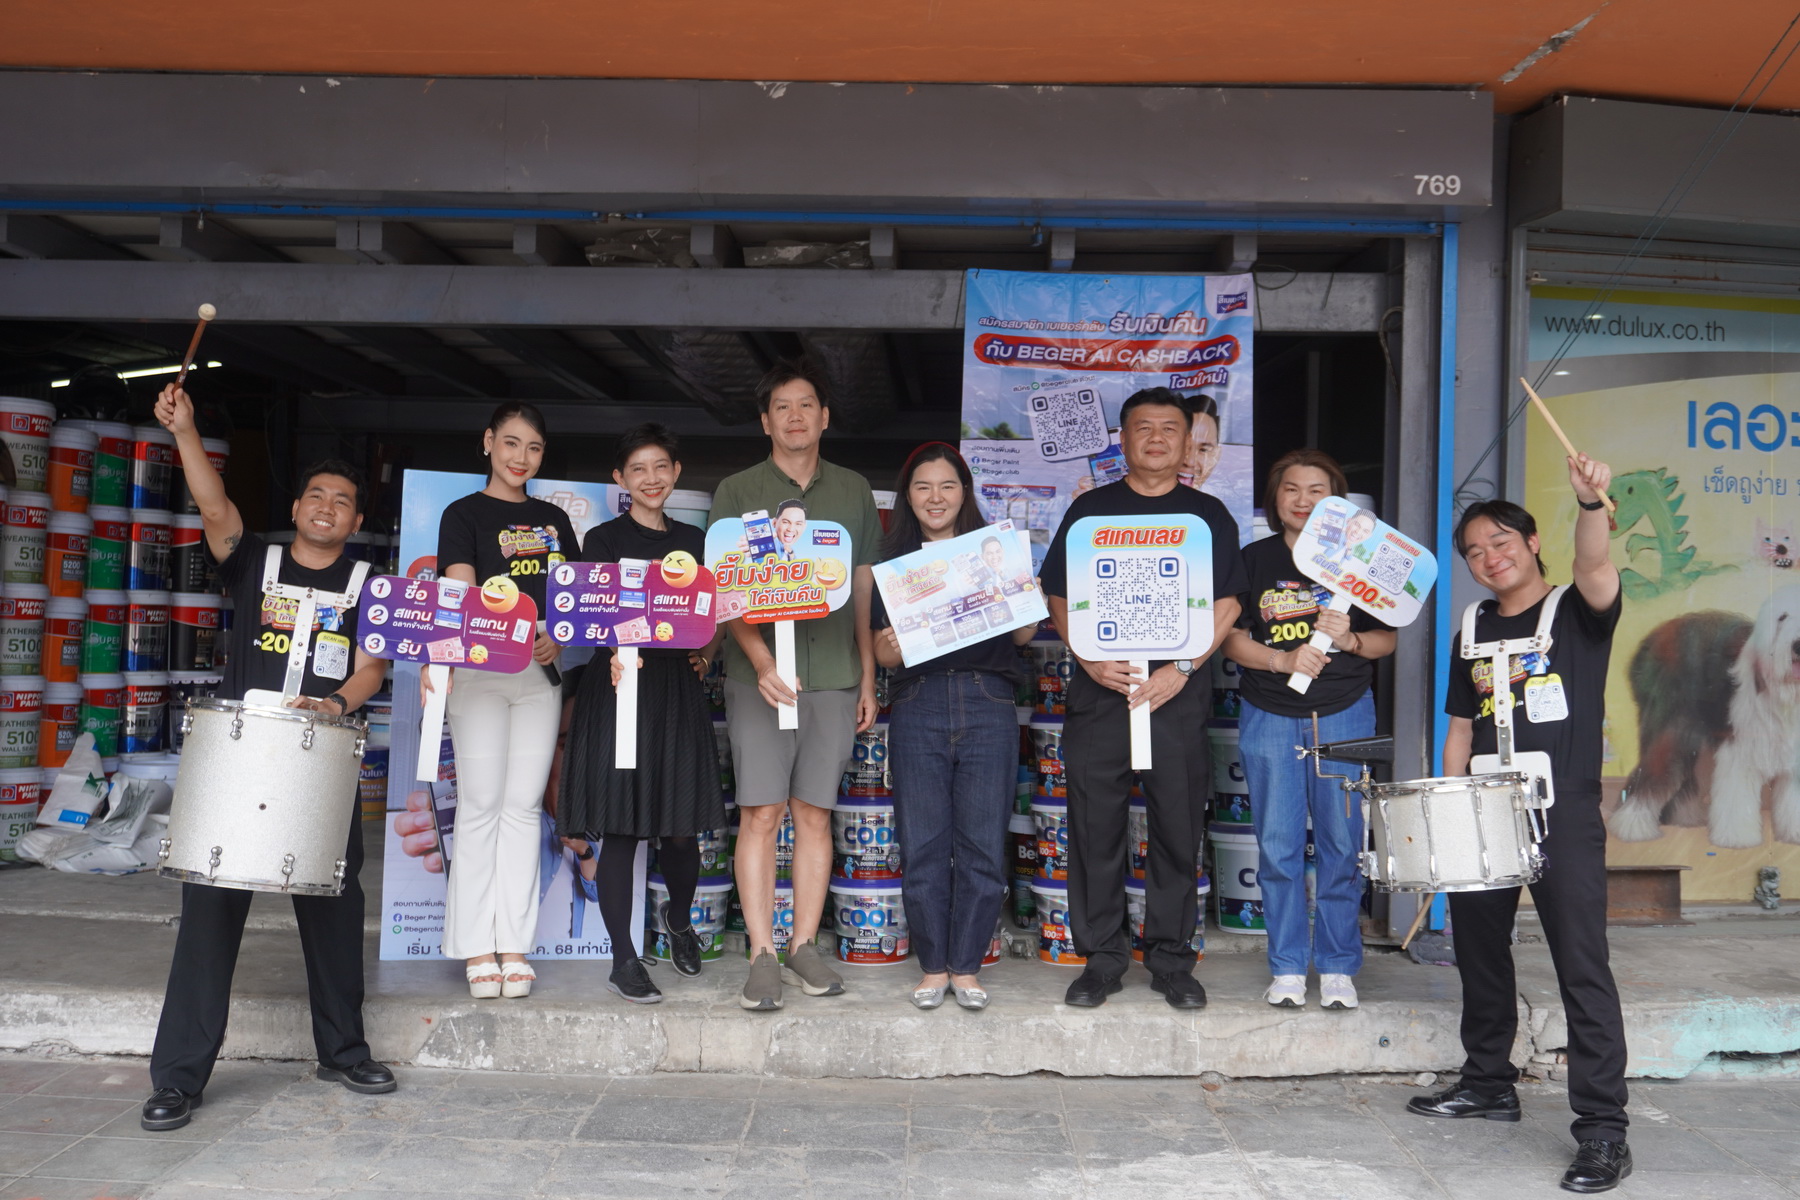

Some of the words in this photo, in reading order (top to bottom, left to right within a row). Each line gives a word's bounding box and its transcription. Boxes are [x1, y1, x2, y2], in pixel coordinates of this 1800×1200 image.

[1414, 174, 1461, 195] 769
[978, 316, 1044, 331] สมัครสมาชิก
[1046, 318, 1106, 332] เบเยอร์คลับ
[1109, 311, 1207, 334] รับเงินคืน
[1545, 315, 1726, 342] www.dulux.co.th
[985, 340, 1013, 358] กับ
[1017, 346, 1088, 363] BEGER
[1090, 348, 1112, 363] AI
[1116, 343, 1233, 365] CASHBACK
[1058, 418, 1079, 428] LINE
[22, 454, 47, 471] 510
[1704, 465, 1787, 504] เช็ดถูง่าย
[813, 529, 840, 538] สีเบเยอร์
[1094, 528, 1186, 547] สแกนเลย
[511, 559, 540, 576] 200
[561, 569, 570, 582] 1
[588, 564, 611, 584] ซื้อ
[715, 555, 809, 588] ยิ้มง่าย
[377, 583, 385, 595] 1
[405, 580, 428, 601] ซื้อ
[750, 585, 822, 606] ได้เงินคืน
[559, 596, 571, 609] 2
[579, 592, 616, 605] สแกน
[653, 594, 690, 606] สแกน
[1124, 594, 1152, 605] LINE
[371, 608, 382, 621] 2
[394, 608, 433, 622] สแกน
[579, 605, 619, 614] ฉลากข้างถัง
[392, 620, 434, 632] ฉลากข้างถัง
[470, 617, 508, 631] สแกน
[558, 624, 570, 637] 3
[585, 623, 609, 640] รับ
[1270, 621, 1310, 643] 200
[261, 632, 291, 654] 20
[369, 637, 381, 649] 3
[397, 638, 422, 656] รับ
[1041, 765, 1053, 774] 100
[861, 817, 886, 826] Beger
[854, 900, 879, 910] Beger
[404, 914, 427, 922] Beger
[840, 908, 899, 928] COOL
[1044, 931, 1057, 939] 100
[407, 937, 431, 956] เริ่ม
[555, 944, 573, 955] 68
[577, 937, 614, 955] เท่านั้
